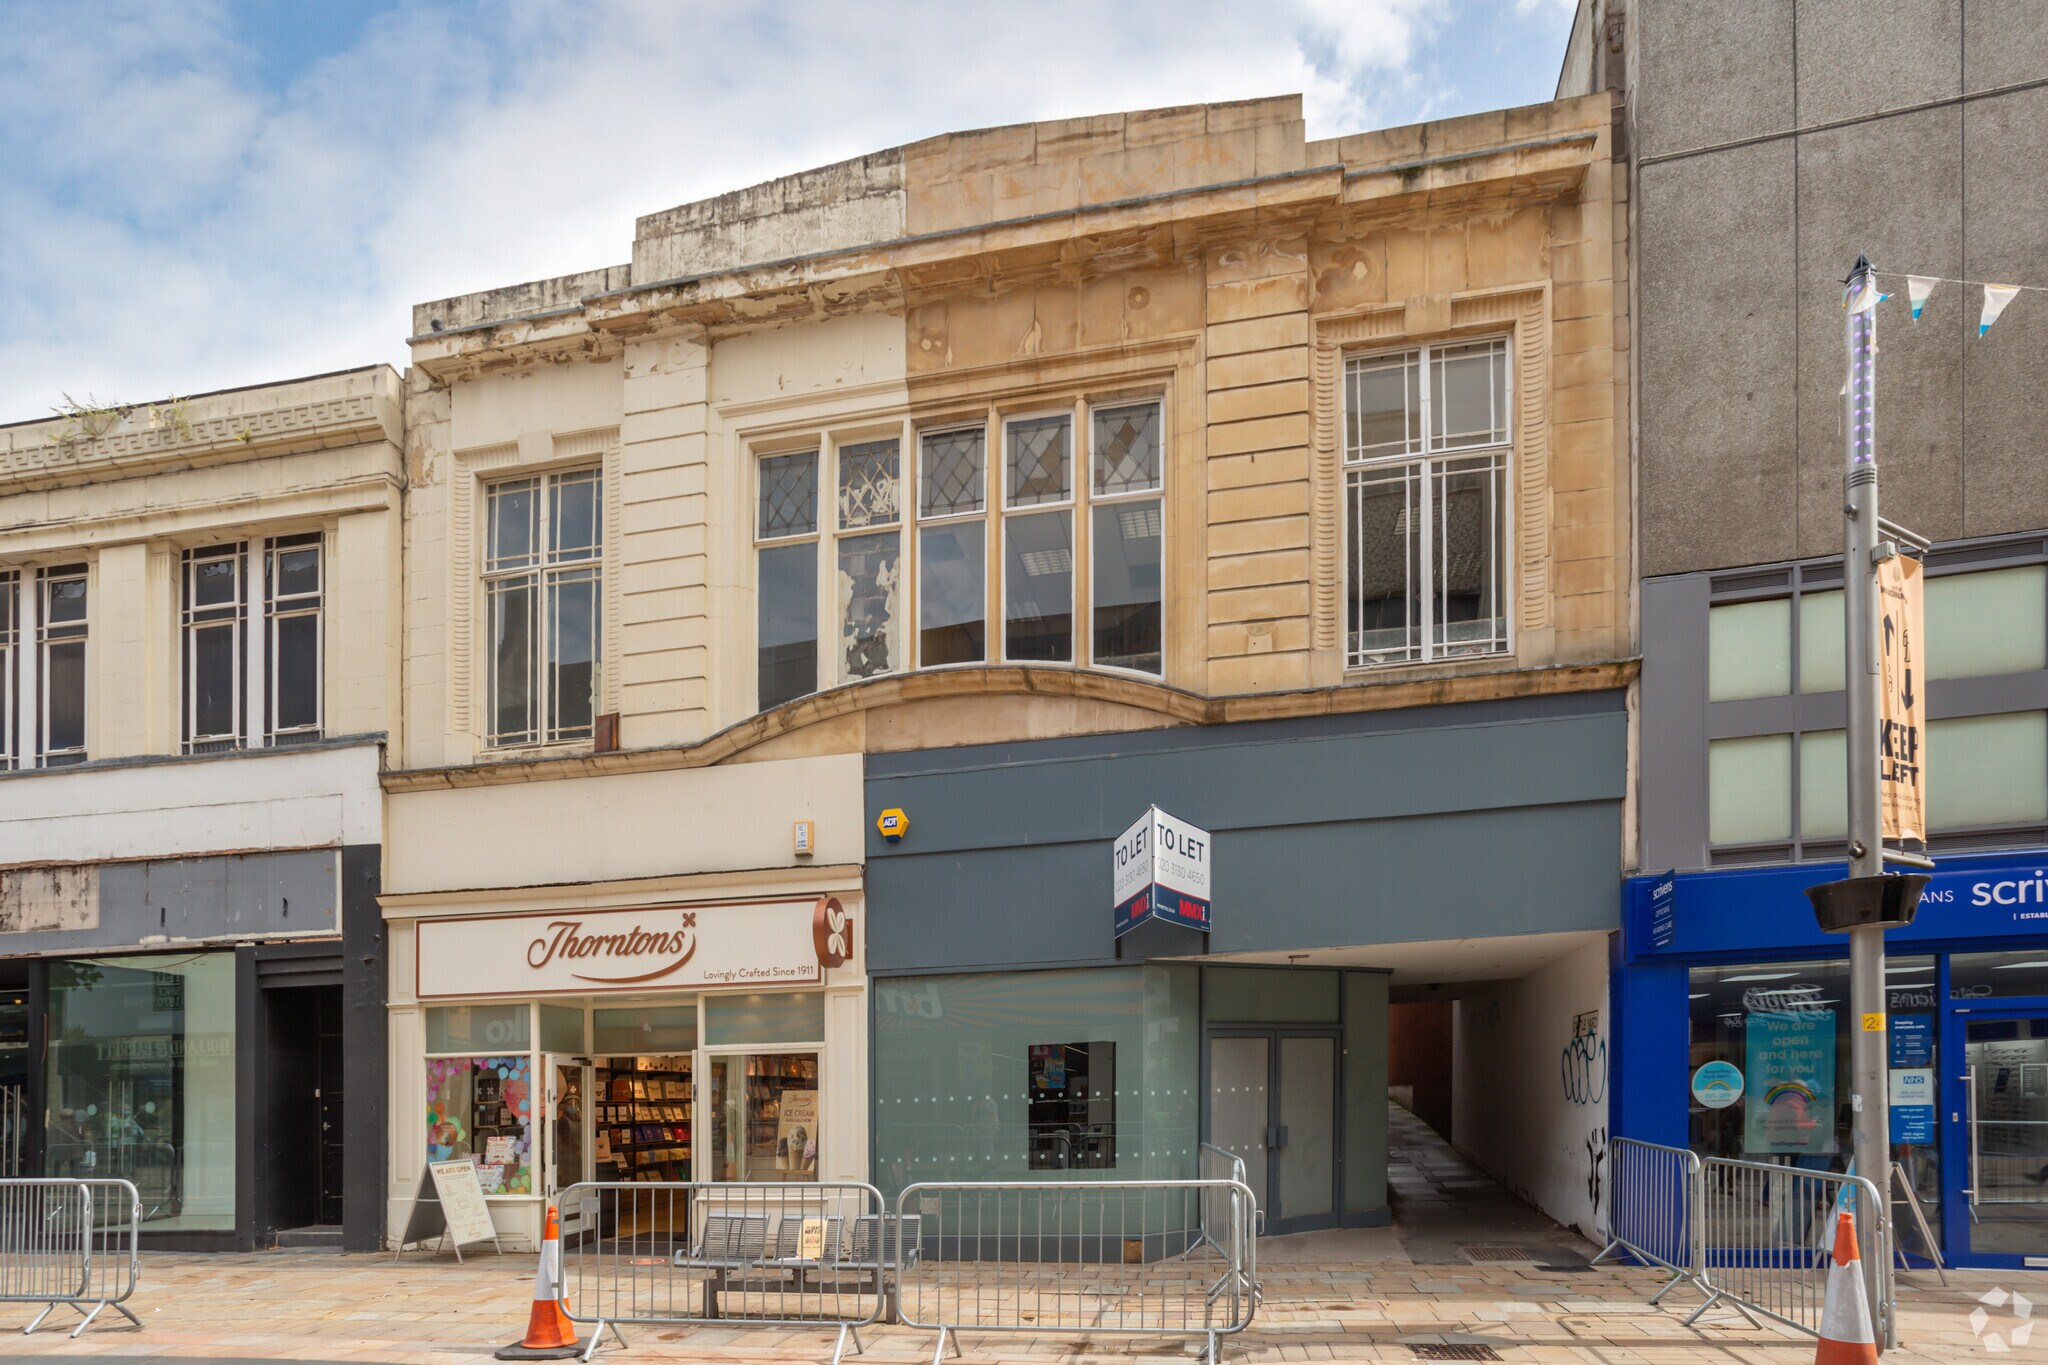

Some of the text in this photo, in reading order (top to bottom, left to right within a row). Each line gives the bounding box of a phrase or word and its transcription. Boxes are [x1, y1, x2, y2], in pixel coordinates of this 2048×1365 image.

[1880, 719, 1918, 763] KEEP
[1880, 760, 1919, 786] LEFT
[883, 818, 897, 827] ADT
[1116, 826, 1148, 870] TO LET
[1157, 823, 1205, 862] TO LET
[1157, 857, 1205, 886] 020 3130 4650
[1653, 881, 1673, 900] scrivens
[1919, 870, 2048, 907] ANS scri
[1179, 898, 1203, 921] MMX
[527, 918, 695, 974] Thorntons
[704, 965, 814, 981] Lovingly Crafted Since 1911
[1767, 1021, 1815, 1031] We are
[1772, 1035, 1809, 1047] open
[1759, 1049, 1823, 1060] and here
[1766, 1063, 1815, 1076] for you
[1904, 1076, 1924, 1084] NHS
[784, 1109, 815, 1117] ICE CREAM
